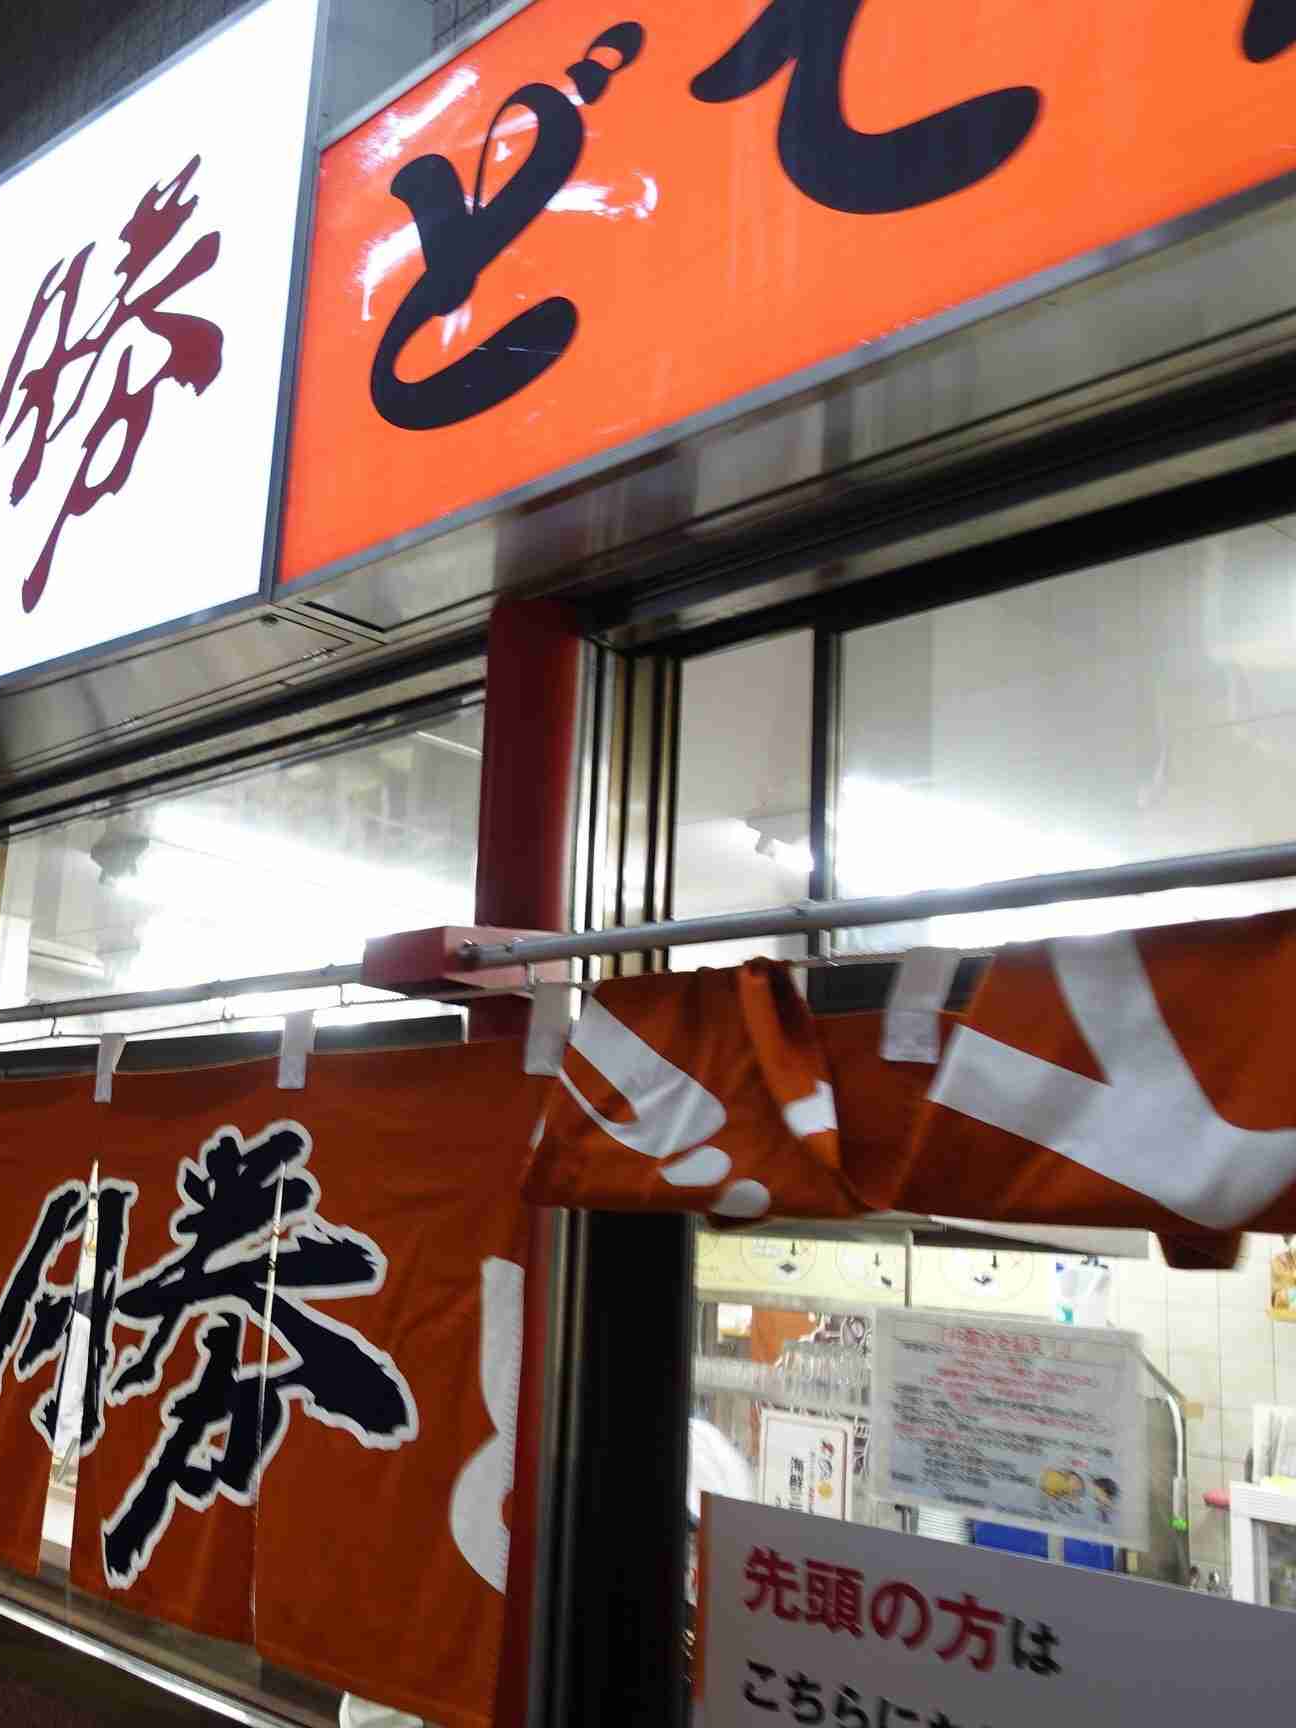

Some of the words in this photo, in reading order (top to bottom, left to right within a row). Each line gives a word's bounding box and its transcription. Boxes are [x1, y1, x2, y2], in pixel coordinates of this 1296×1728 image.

[368, 0, 1296, 432] どて
[743, 1543, 1063, 1677] 先頭の方は
